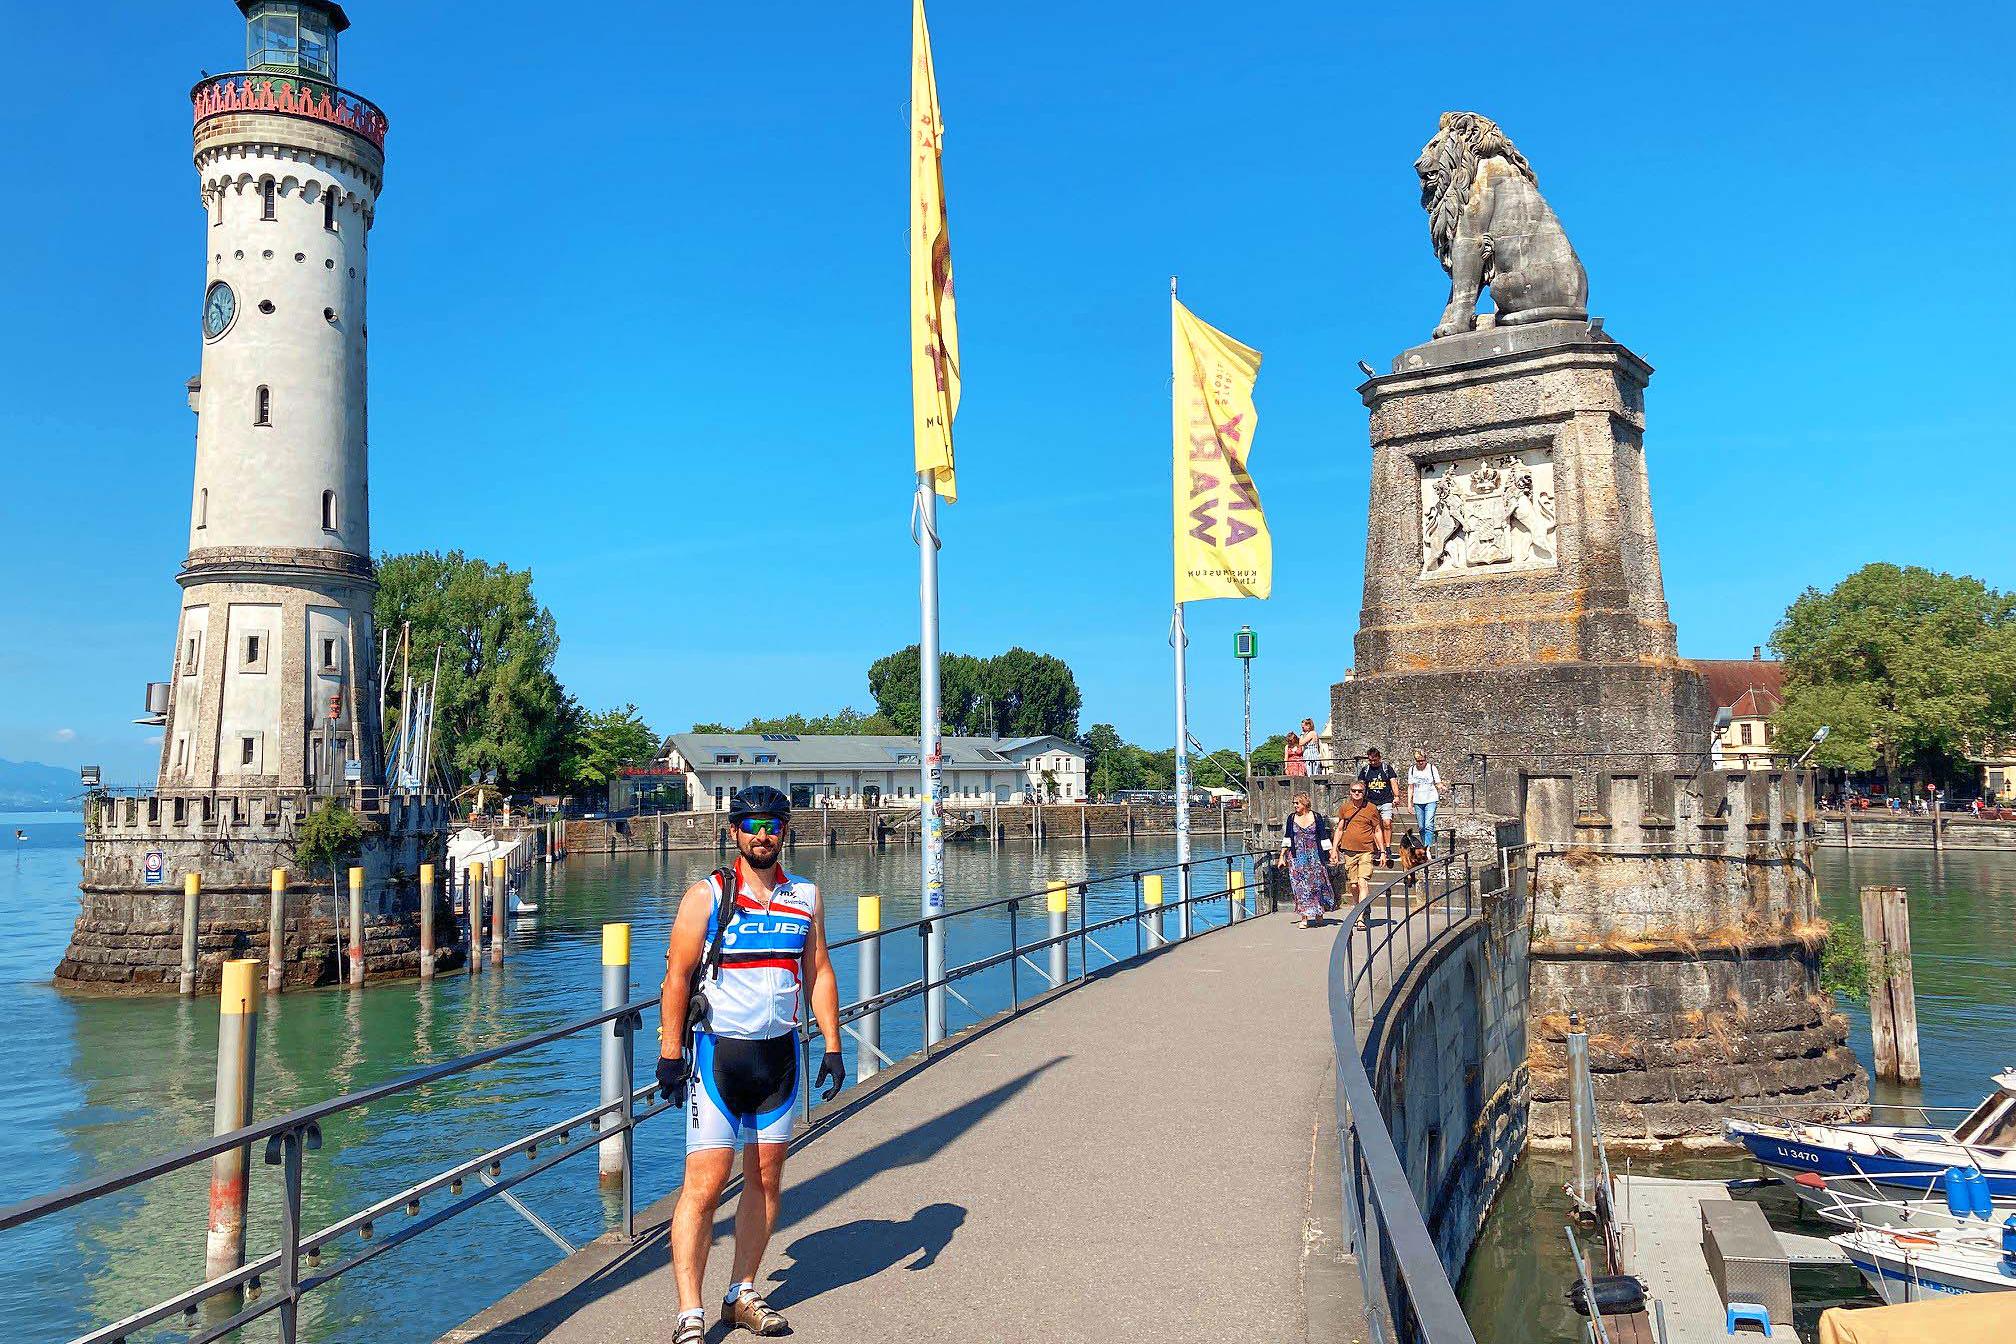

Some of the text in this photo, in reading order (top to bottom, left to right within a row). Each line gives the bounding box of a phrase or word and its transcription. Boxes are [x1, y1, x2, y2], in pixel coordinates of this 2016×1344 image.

[738, 922, 810, 936] CUBE
[690, 1085, 700, 1129] CUBE
[1777, 1146, 1819, 1163] LI 3470
